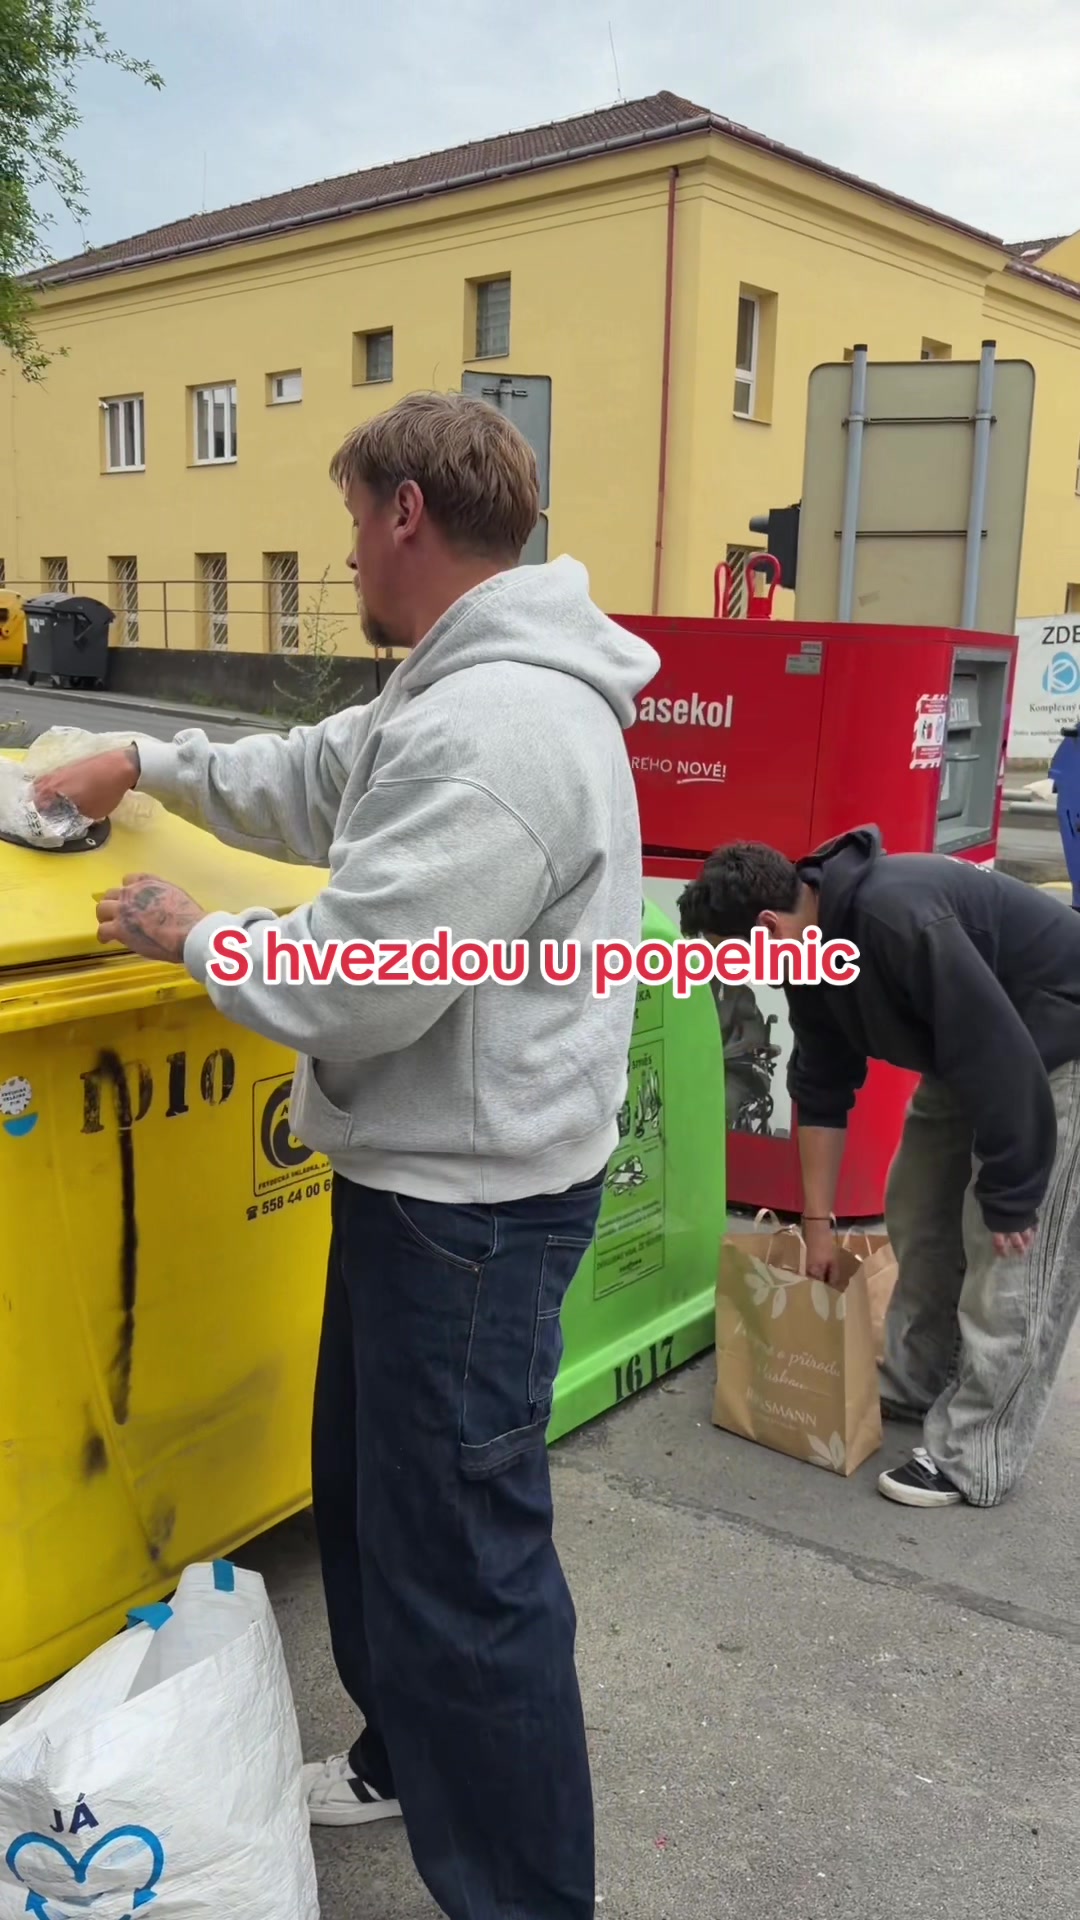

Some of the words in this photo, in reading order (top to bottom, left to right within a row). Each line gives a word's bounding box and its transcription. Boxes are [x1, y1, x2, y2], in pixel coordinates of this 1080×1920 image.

[639, 692, 733, 728] asekol
[677, 761, 727, 778] NOVÉ!
[262, 1195, 284, 1215] 558
[287, 1187, 303, 1204] 44
[305, 1179, 320, 1199] 00
[614, 1335, 674, 1401] 1617
[49, 1792, 100, 1834] JÁ
